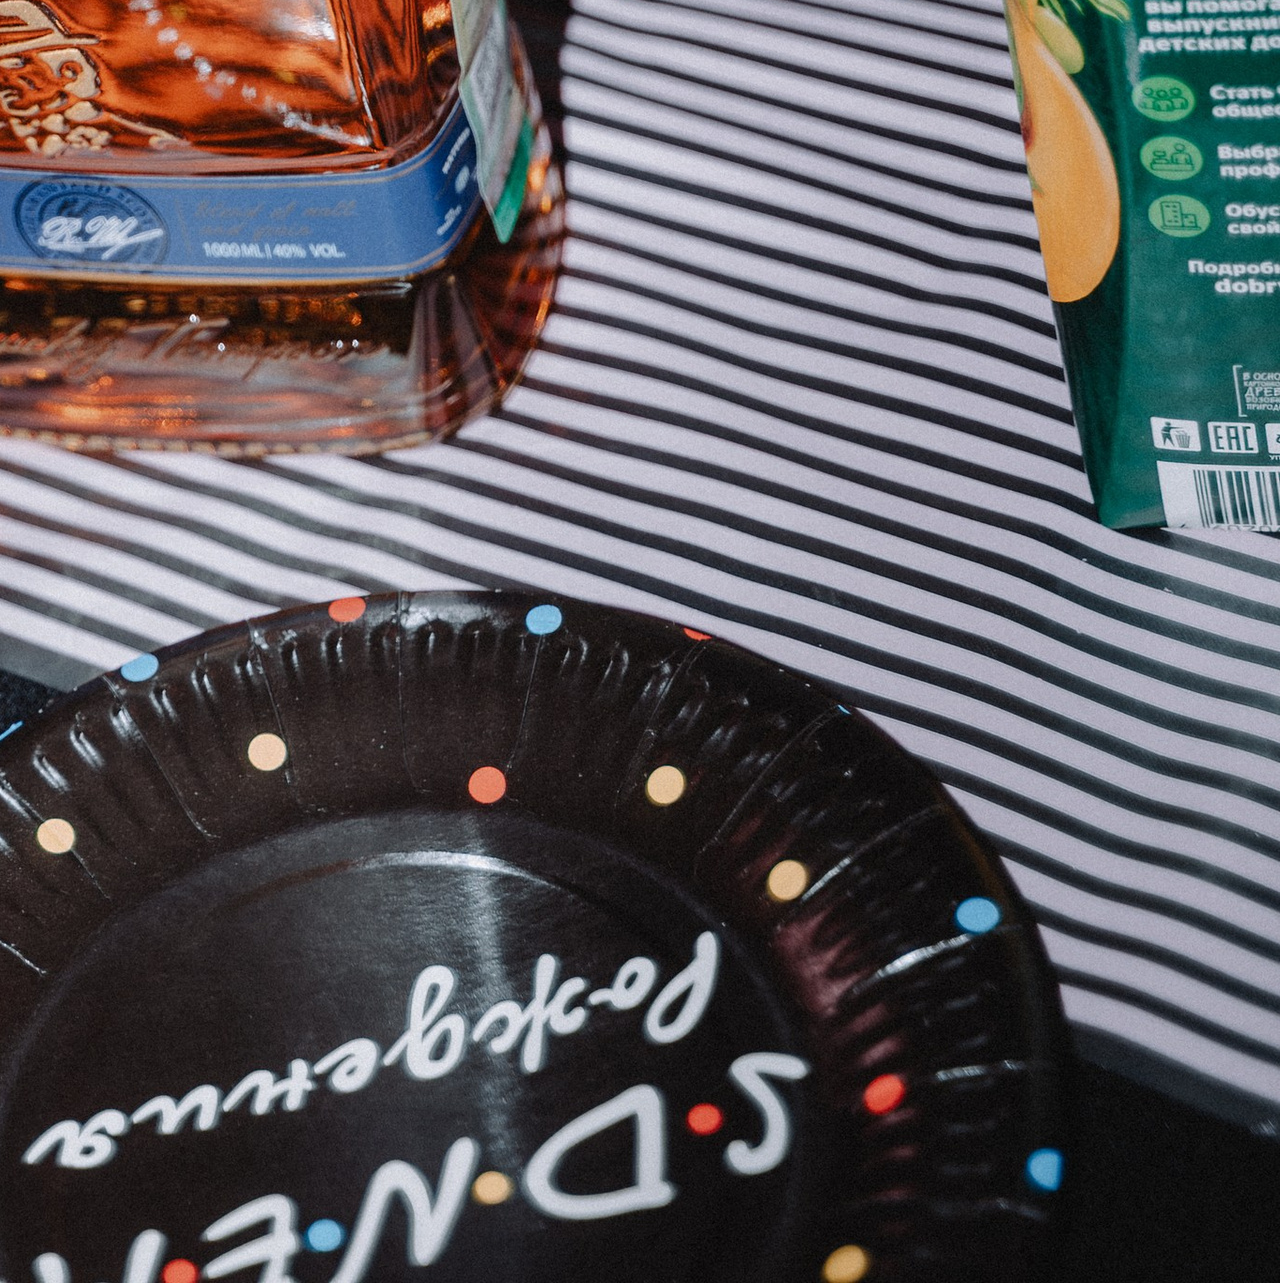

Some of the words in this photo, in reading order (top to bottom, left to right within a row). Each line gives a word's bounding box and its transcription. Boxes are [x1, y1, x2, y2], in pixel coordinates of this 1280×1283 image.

[1144, 0, 1183, 15] вы
[1138, 37, 1247, 54] детских
[1208, 83, 1275, 101] Стать
[1213, 425, 1255, 451] EAC
